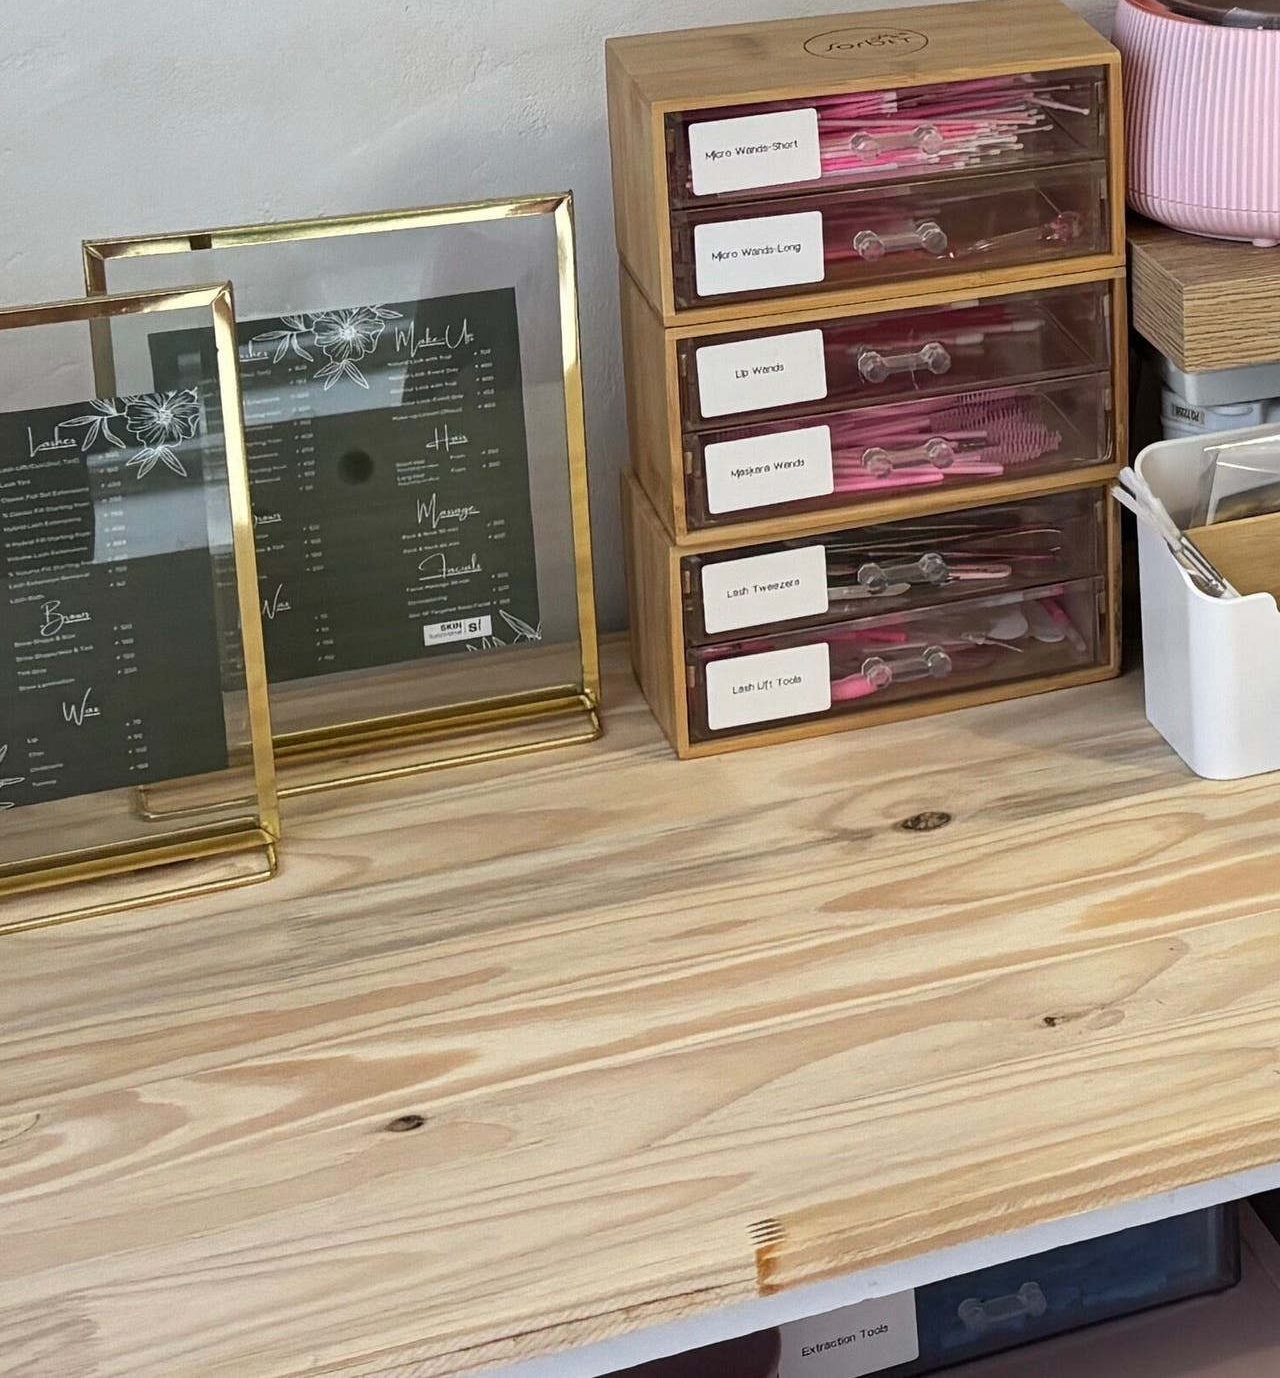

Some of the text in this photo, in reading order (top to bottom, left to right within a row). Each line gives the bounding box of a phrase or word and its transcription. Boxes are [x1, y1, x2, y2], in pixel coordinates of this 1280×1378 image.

[705, 149, 732, 162] Micro
[711, 250, 738, 262] Micro
[735, 363, 785, 379] Lip Wands
[773, 458, 805, 471] Wands
[416, 492, 480, 529] Massage
[727, 579, 801, 599] Lash Tweezers
[732, 683, 755, 695] Lash
[775, 675, 802, 687] Tools
[801, 1324, 889, 1357] Extraction Tools
